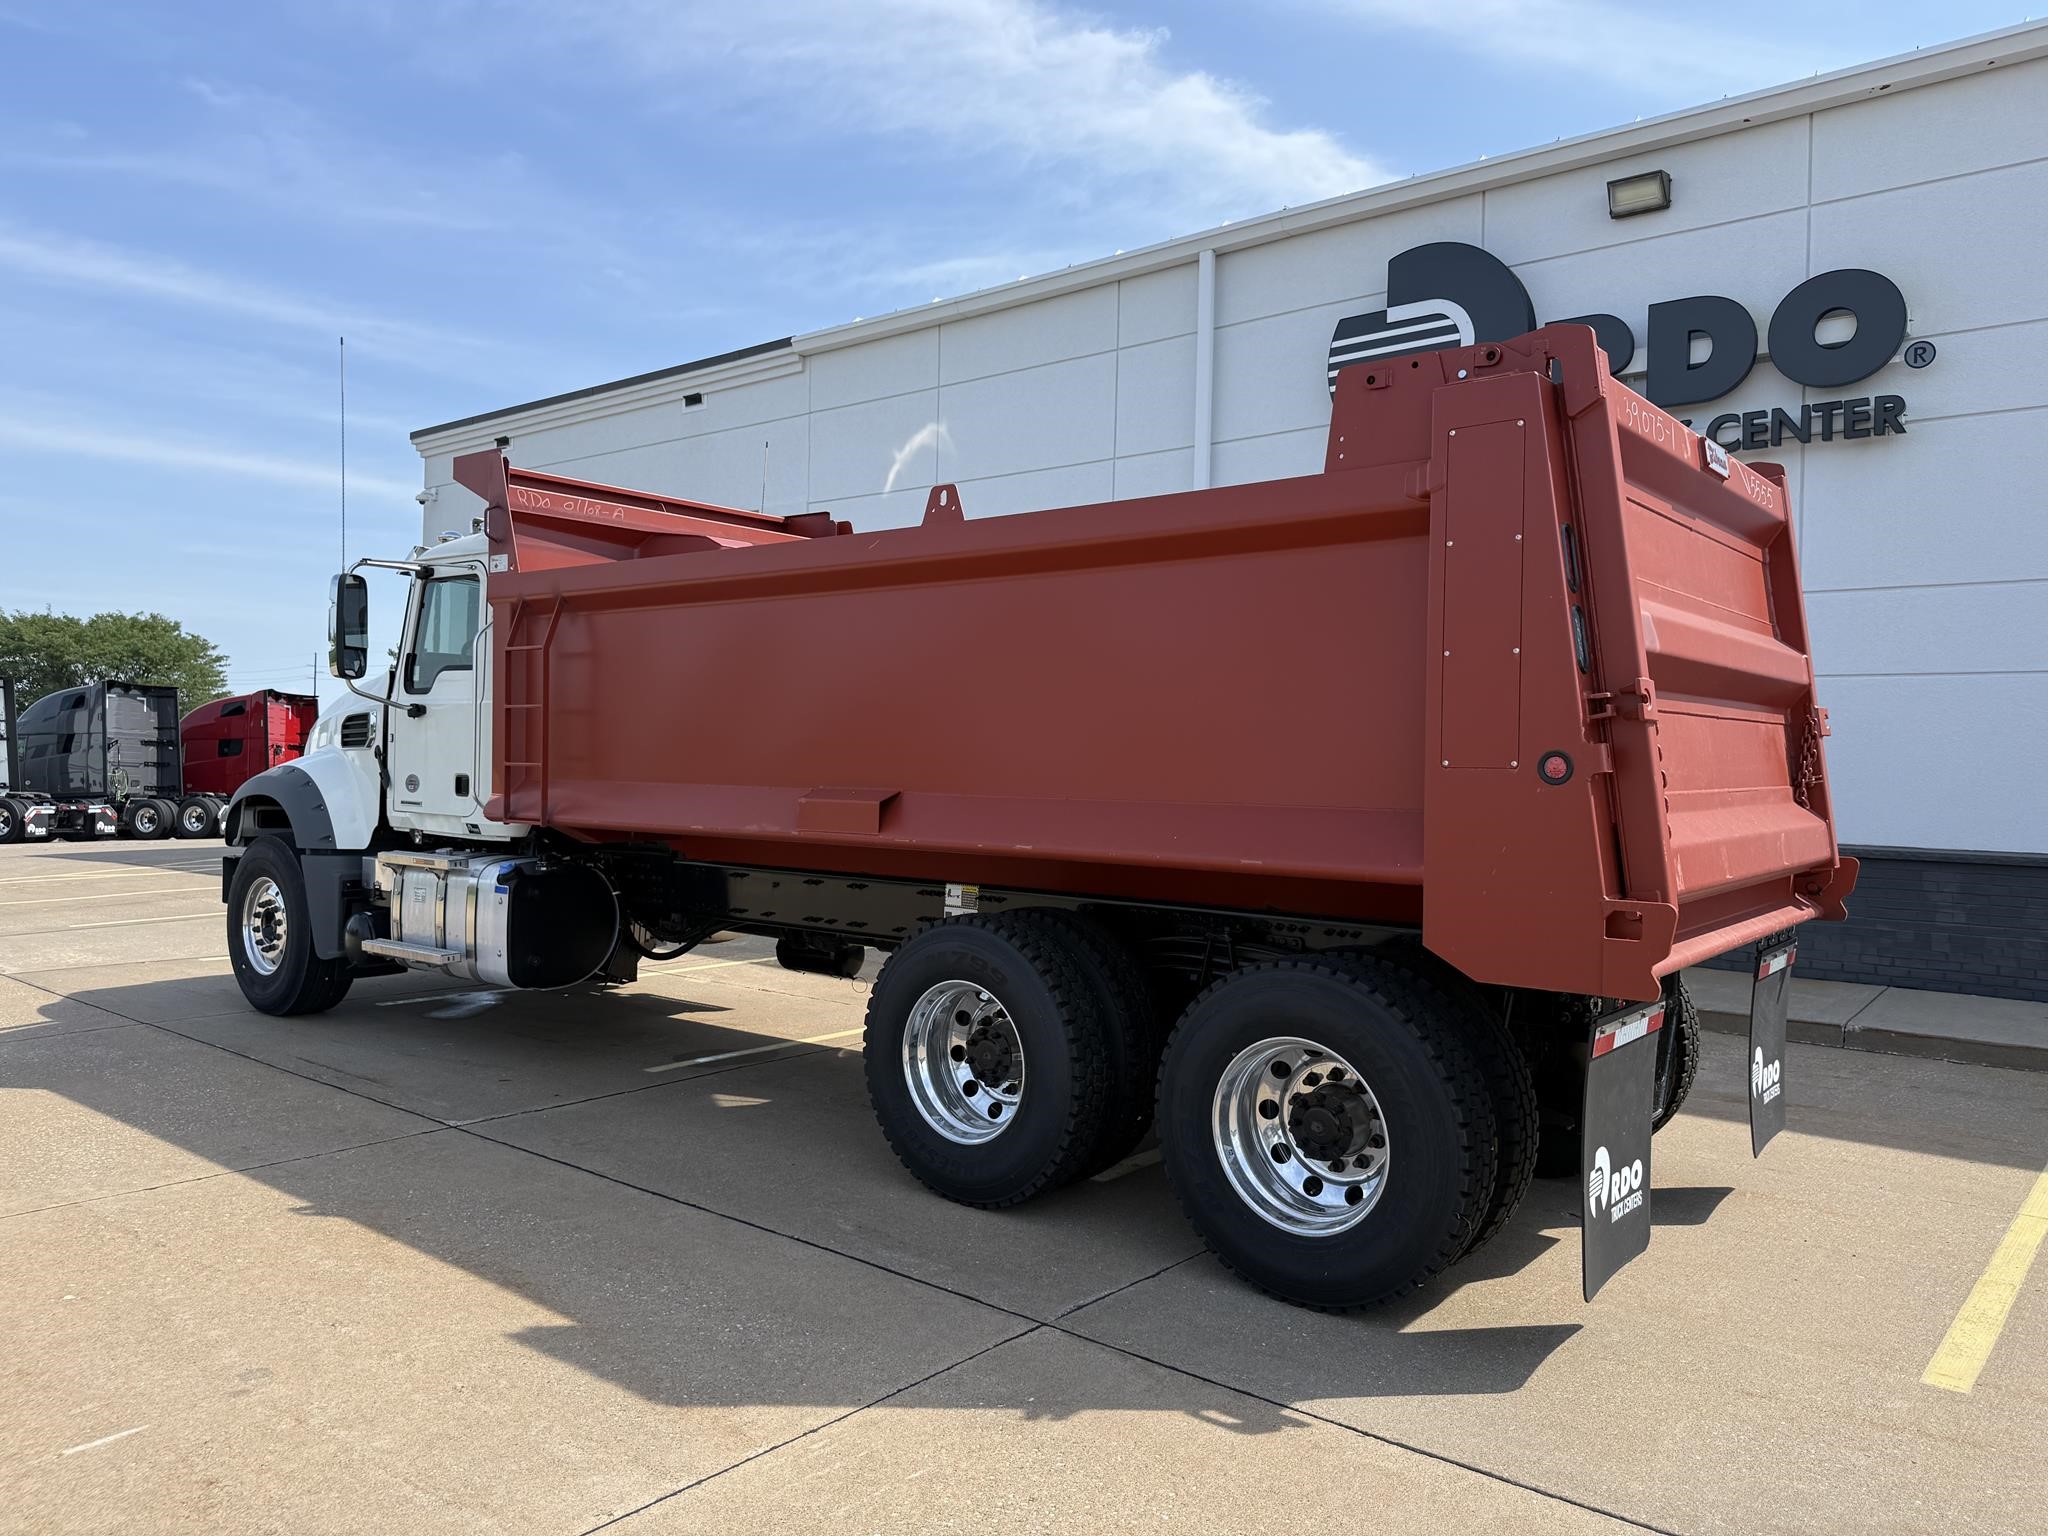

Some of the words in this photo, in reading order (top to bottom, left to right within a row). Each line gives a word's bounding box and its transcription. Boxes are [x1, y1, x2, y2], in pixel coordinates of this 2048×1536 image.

[1705, 394, 1907, 454] CENTER
[1763, 1059, 1780, 1092] RDO
[1611, 1158, 1643, 1205] RDO
